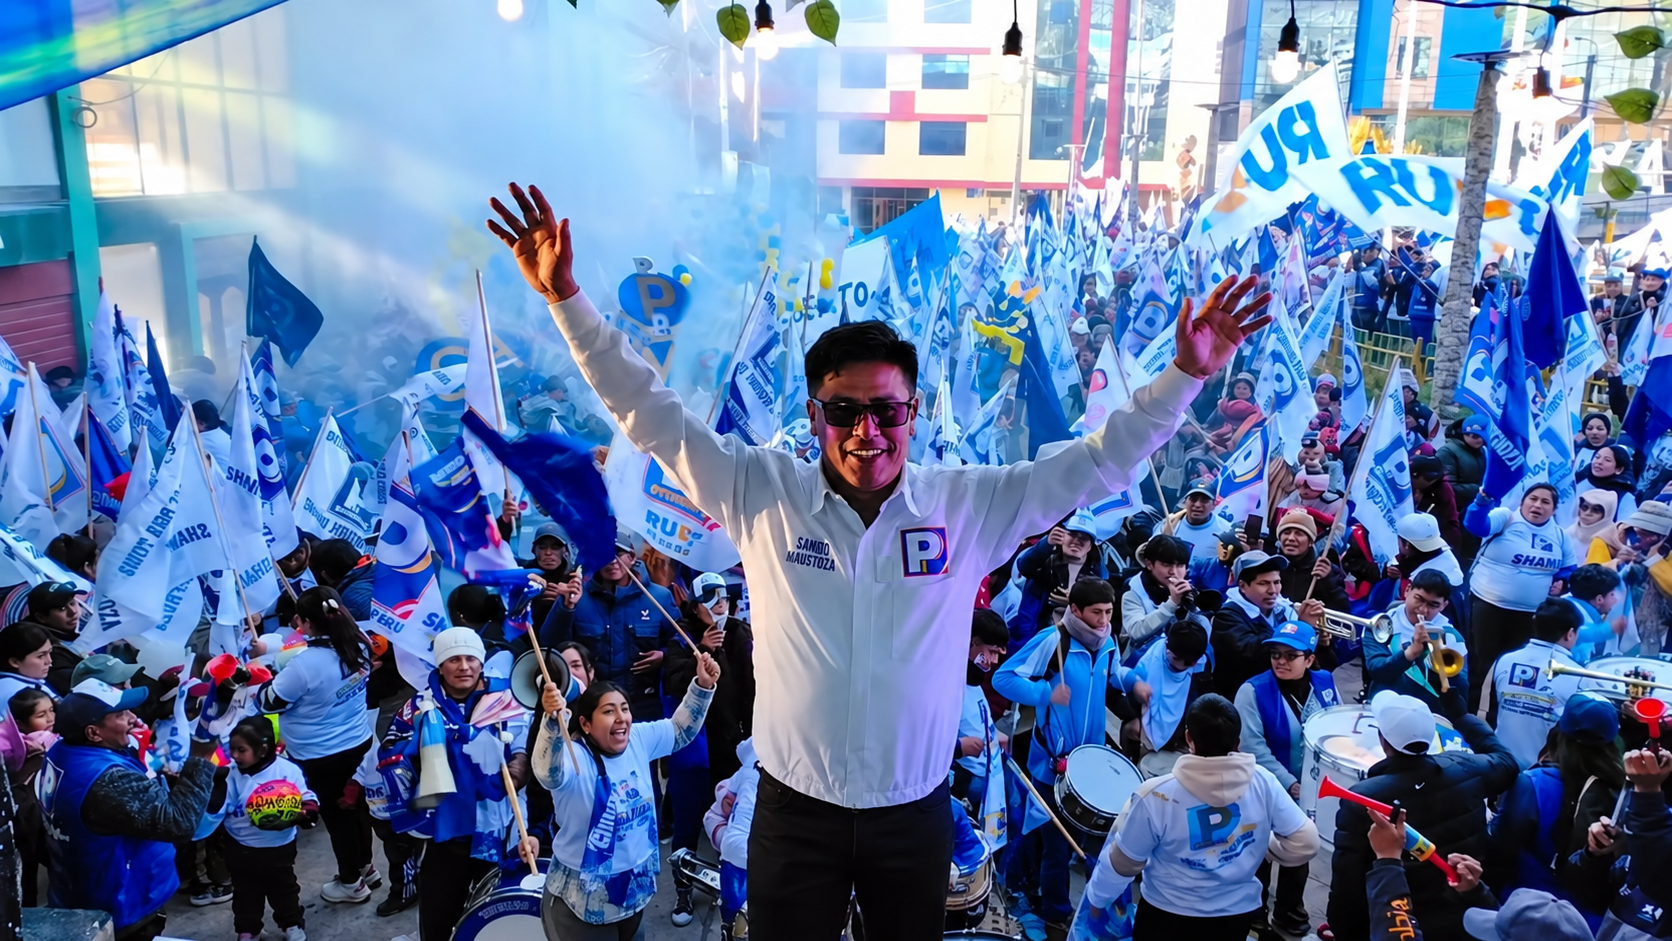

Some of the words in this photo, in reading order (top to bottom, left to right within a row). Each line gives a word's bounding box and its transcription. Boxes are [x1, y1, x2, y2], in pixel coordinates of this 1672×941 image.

[636, 277, 676, 321] P
[785, 551, 836, 572] MAUSTOZA
[905, 530, 943, 574] P
[371, 608, 405, 634] PERU
[1196, 806, 1233, 843] P
